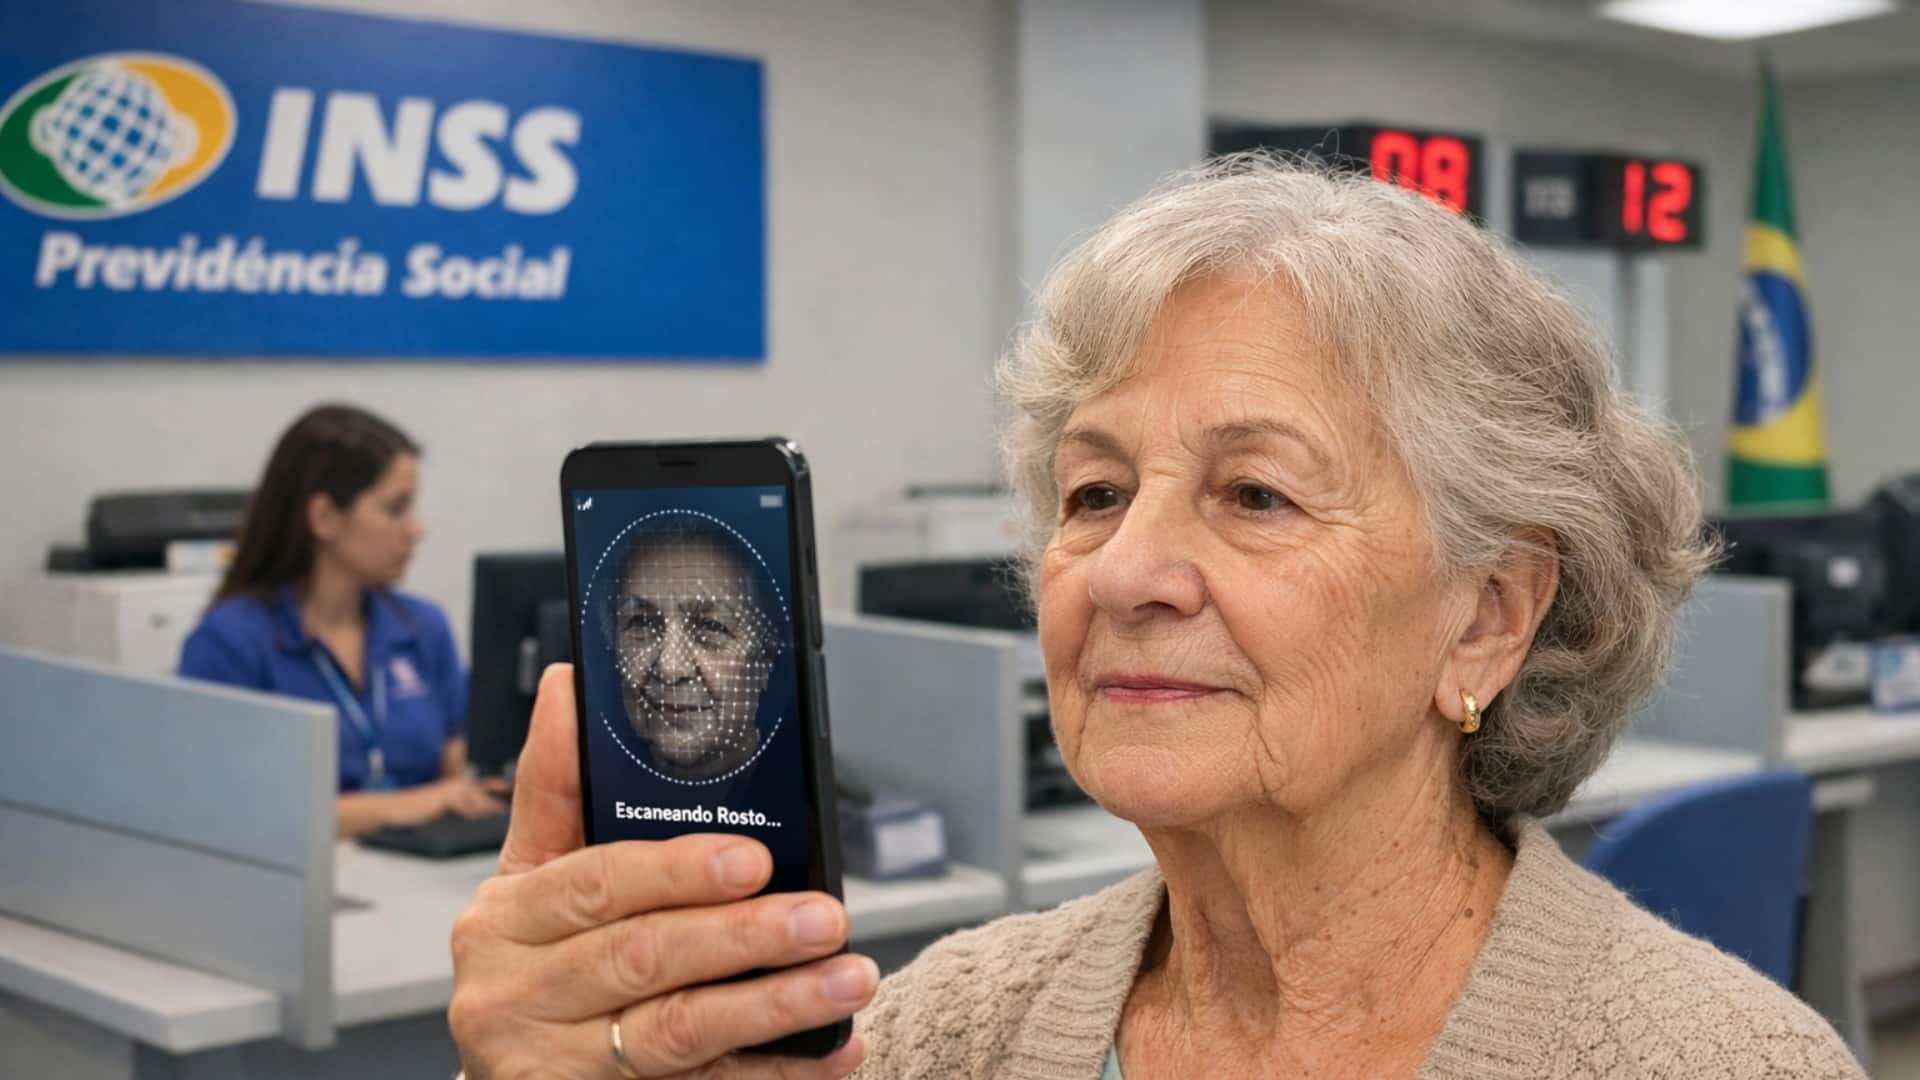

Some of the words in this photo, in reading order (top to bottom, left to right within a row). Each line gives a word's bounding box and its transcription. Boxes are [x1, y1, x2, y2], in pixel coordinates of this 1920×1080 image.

[256, 88, 581, 214] INSS
[1623, 162, 1692, 242] 12
[401, 244, 571, 299] Social
[615, 801, 713, 823] Escaneando
[717, 806, 782, 827] Rosto...
